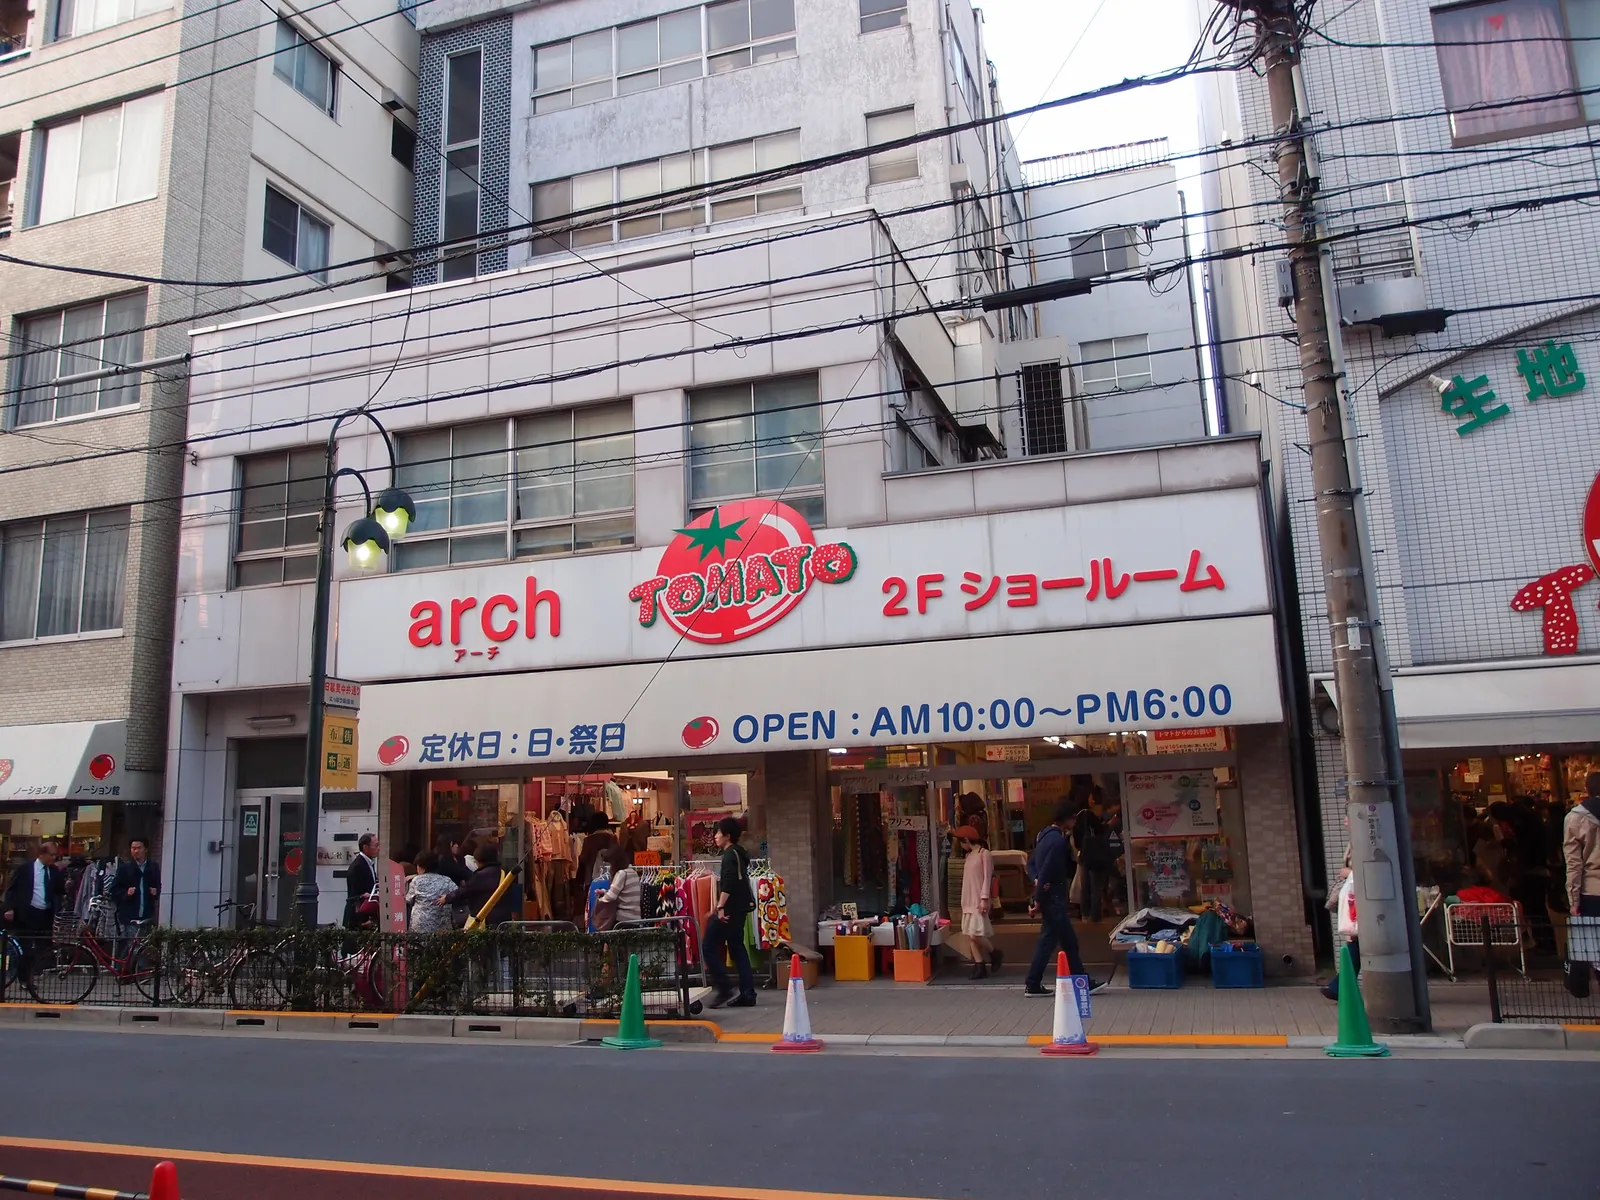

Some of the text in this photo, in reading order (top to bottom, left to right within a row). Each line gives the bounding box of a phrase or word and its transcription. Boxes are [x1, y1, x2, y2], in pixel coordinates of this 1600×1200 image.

[1441, 339, 1586, 437] 生地
[408, 575, 561, 648] arch
[629, 542, 858, 627] TOMATO
[882, 549, 1226, 617] 2F ショールーム
[454, 646, 500, 662] アーチ
[733, 709, 836, 744] OPEN
[75, 785, 120, 796] ノーション館
